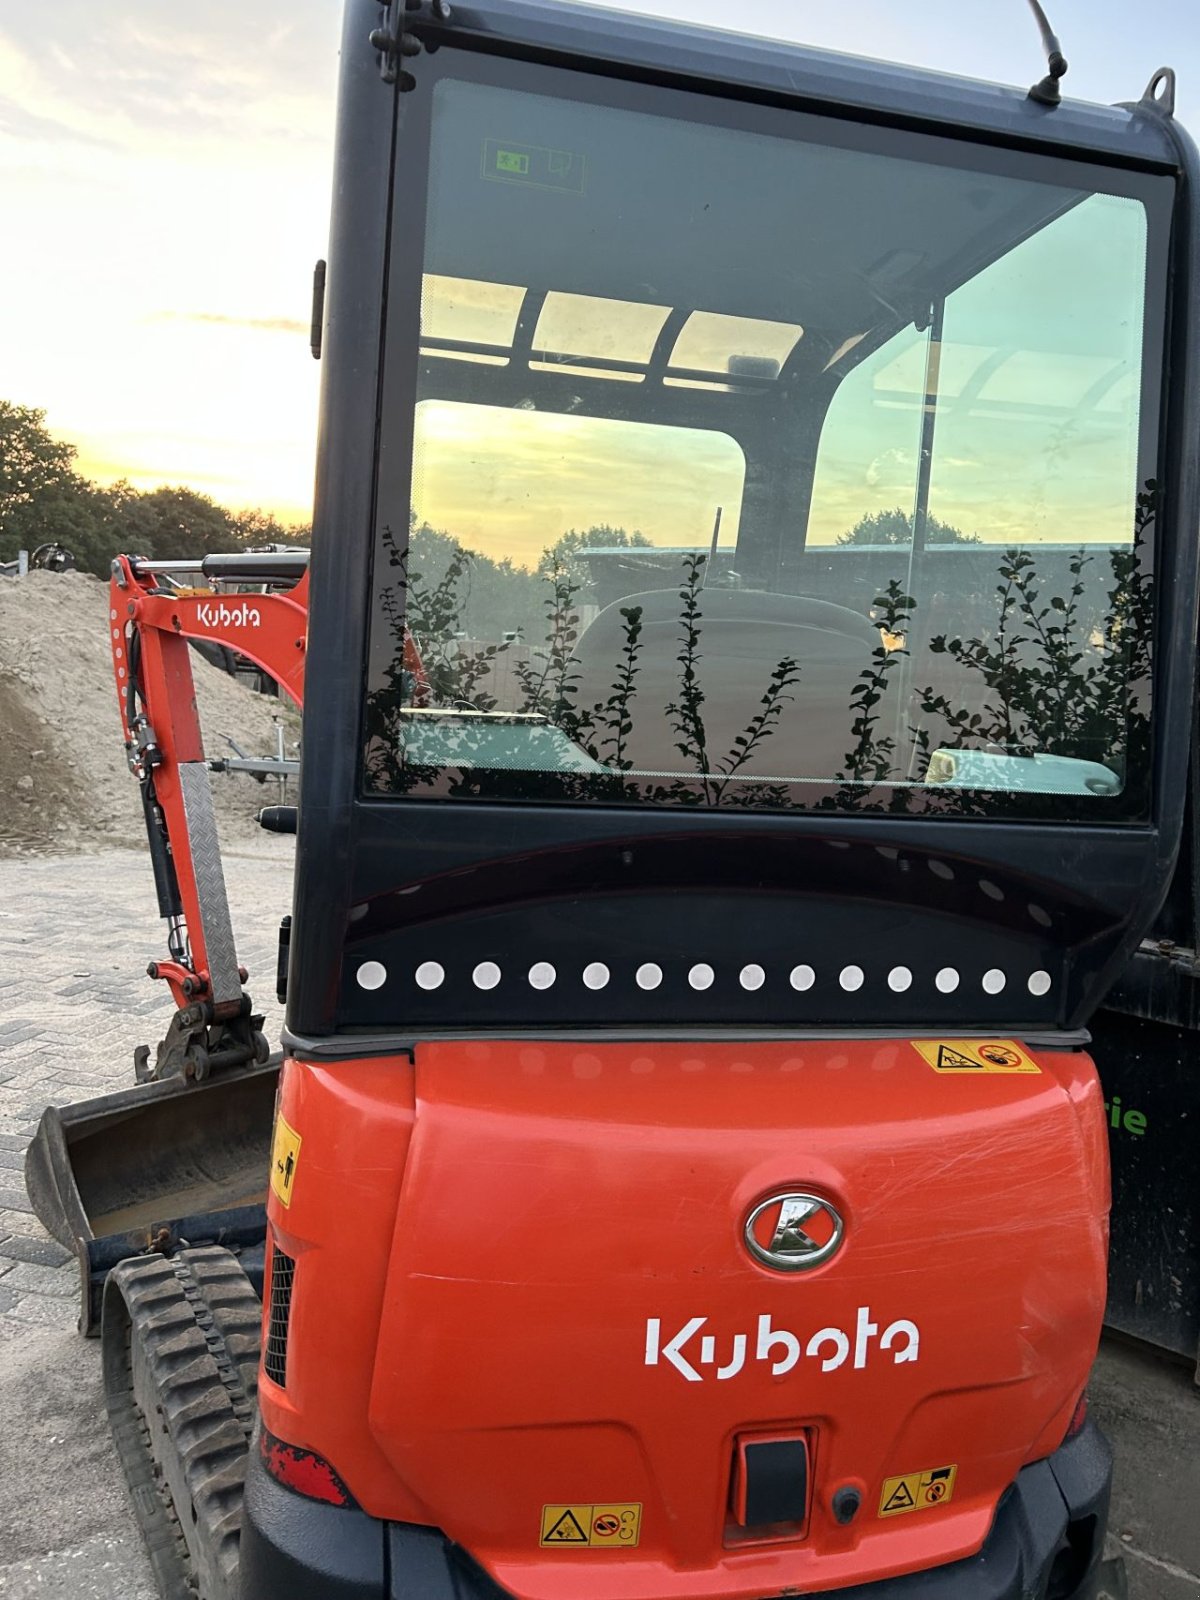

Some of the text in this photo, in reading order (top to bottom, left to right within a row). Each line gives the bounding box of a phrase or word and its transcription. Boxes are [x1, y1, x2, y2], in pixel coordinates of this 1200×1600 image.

[197, 602, 261, 627] Kubota
[1104, 1096, 1147, 1135] ie
[644, 1306, 920, 1382] Kubota
